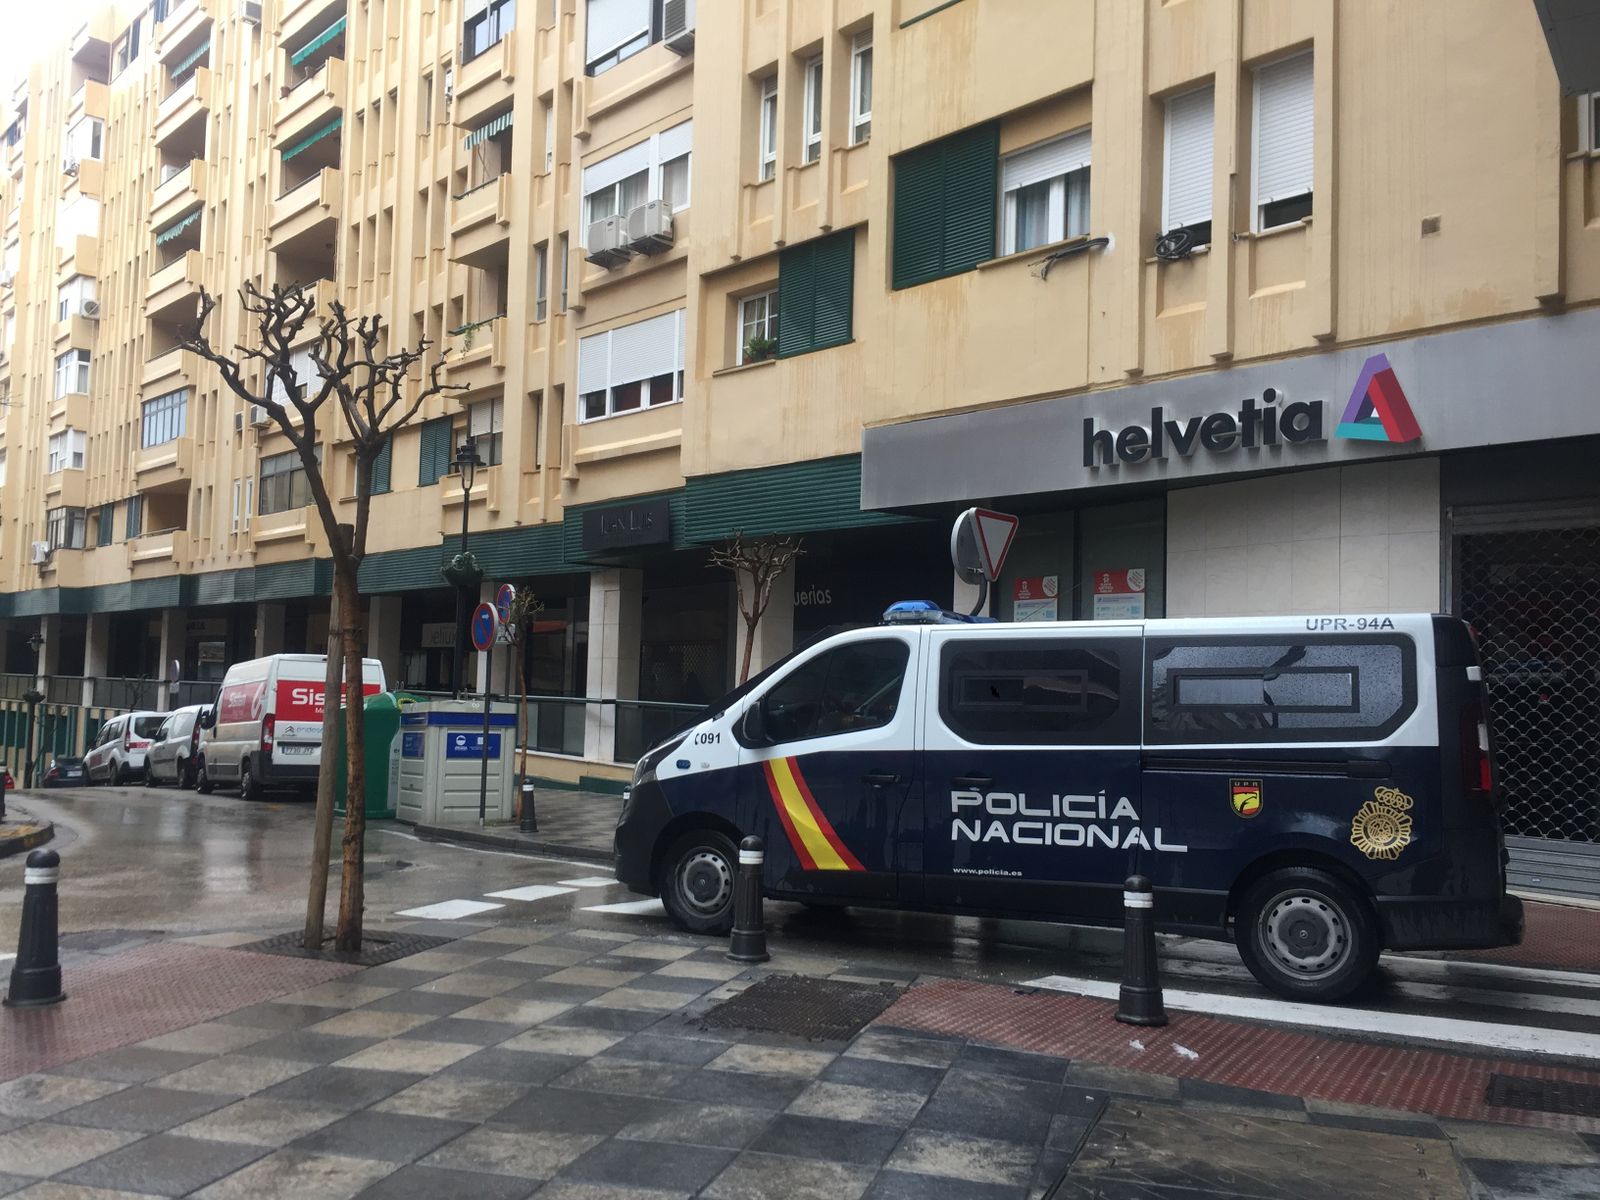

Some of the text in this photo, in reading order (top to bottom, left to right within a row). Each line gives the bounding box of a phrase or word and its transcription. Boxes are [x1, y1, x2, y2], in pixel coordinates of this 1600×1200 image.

[1083, 388, 1325, 468] helvetia
[1306, 617, 1395, 631] UPR-94A
[700, 732, 721, 744] 091
[951, 789, 1140, 821] POLICÍA
[951, 818, 1188, 853] NACIONAL
[953, 867, 1023, 877] www.policia.es
